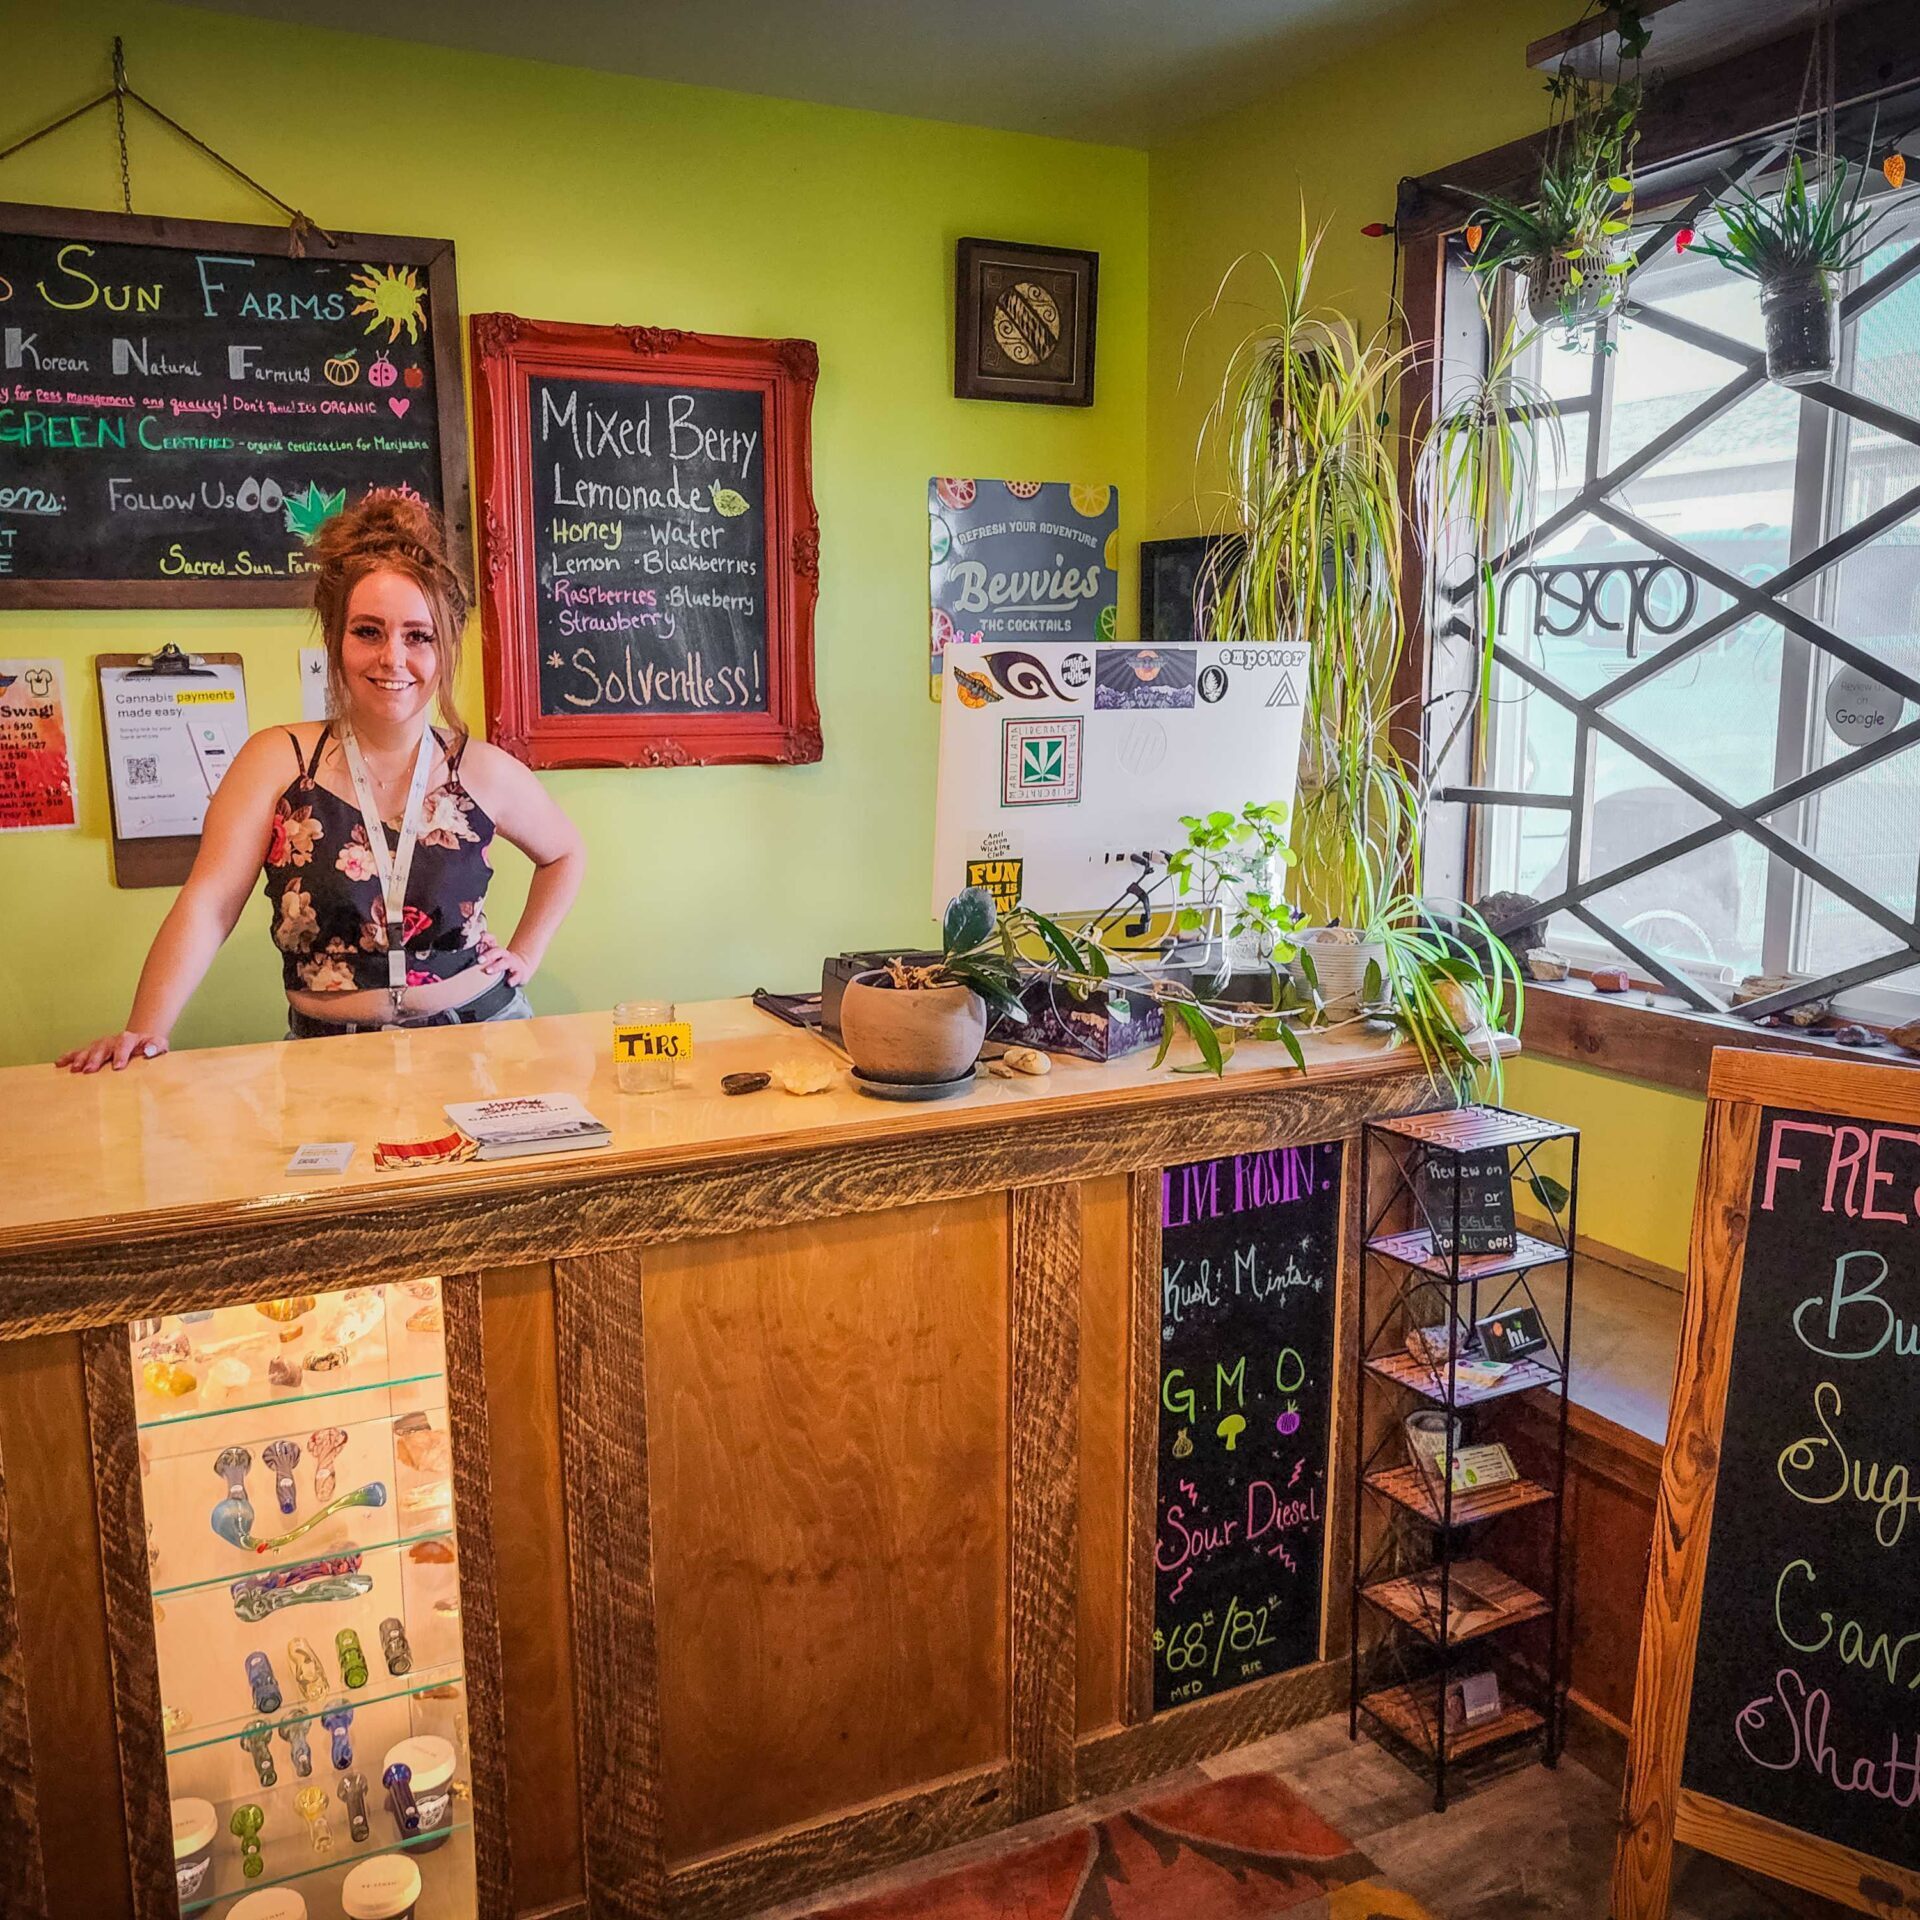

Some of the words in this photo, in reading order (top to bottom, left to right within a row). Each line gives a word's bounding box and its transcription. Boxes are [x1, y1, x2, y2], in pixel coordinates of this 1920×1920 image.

[195, 256, 345, 320] FARMS
[4, 327, 89, 371] Korean
[112, 337, 202, 376] Natural
[228, 345, 310, 383] Farming
[14, 384, 32, 402] for
[66, 392, 136, 408] management
[233, 396, 265, 413] Don't
[320, 400, 377, 415] ORGANIC
[0, 409, 125, 449] GREEN
[246, 441, 283, 454] organic
[287, 439, 354, 453] certification
[356, 437, 372, 451] for
[373, 435, 430, 453] Marijuana
[541, 387, 652, 461] Mixed
[667, 394, 758, 479] Berry
[553, 462, 711, 513] Lemonade
[552, 519, 623, 551] Honey
[958, 522, 1006, 545] REFRESH
[1008, 521, 1037, 532] YOUR
[1039, 522, 1098, 549] ADVENTURE
[551, 551, 621, 577] Lemon
[642, 550, 758, 577] Blackberries
[554, 579, 658, 607] Raspberries
[669, 585, 755, 617] Blueberry
[950, 553, 1101, 614] Bevvies
[558, 609, 677, 640] Strawberry
[979, 618, 1004, 632] THC
[1007, 619, 1072, 632] COCKTAILS
[1219, 649, 1306, 671] empower
[115, 693, 174, 705] Cannabis
[176, 690, 235, 704] payments
[118, 708, 151, 718] made
[1018, 724, 1068, 735] LIBERATE
[1835, 708, 1885, 729] Google
[983, 838, 1008, 846] Cotton
[969, 861, 1021, 885] FUN
[1005, 882, 1018, 894] IS
[1427, 1161, 1480, 1179] Revew
[1486, 1166, 1503, 1176] on
[1761, 1120, 1920, 1225] FRE
[1162, 1160, 1224, 1228] LIVE
[1484, 1193, 1500, 1203] or
[1163, 1259, 1220, 1322] Kush
[1778, 1382, 1920, 1548] Sug
[1154, 1505, 1238, 1572] Sour
[1246, 1480, 1320, 1541] Diesel
[1170, 1680, 1203, 1702] MED
